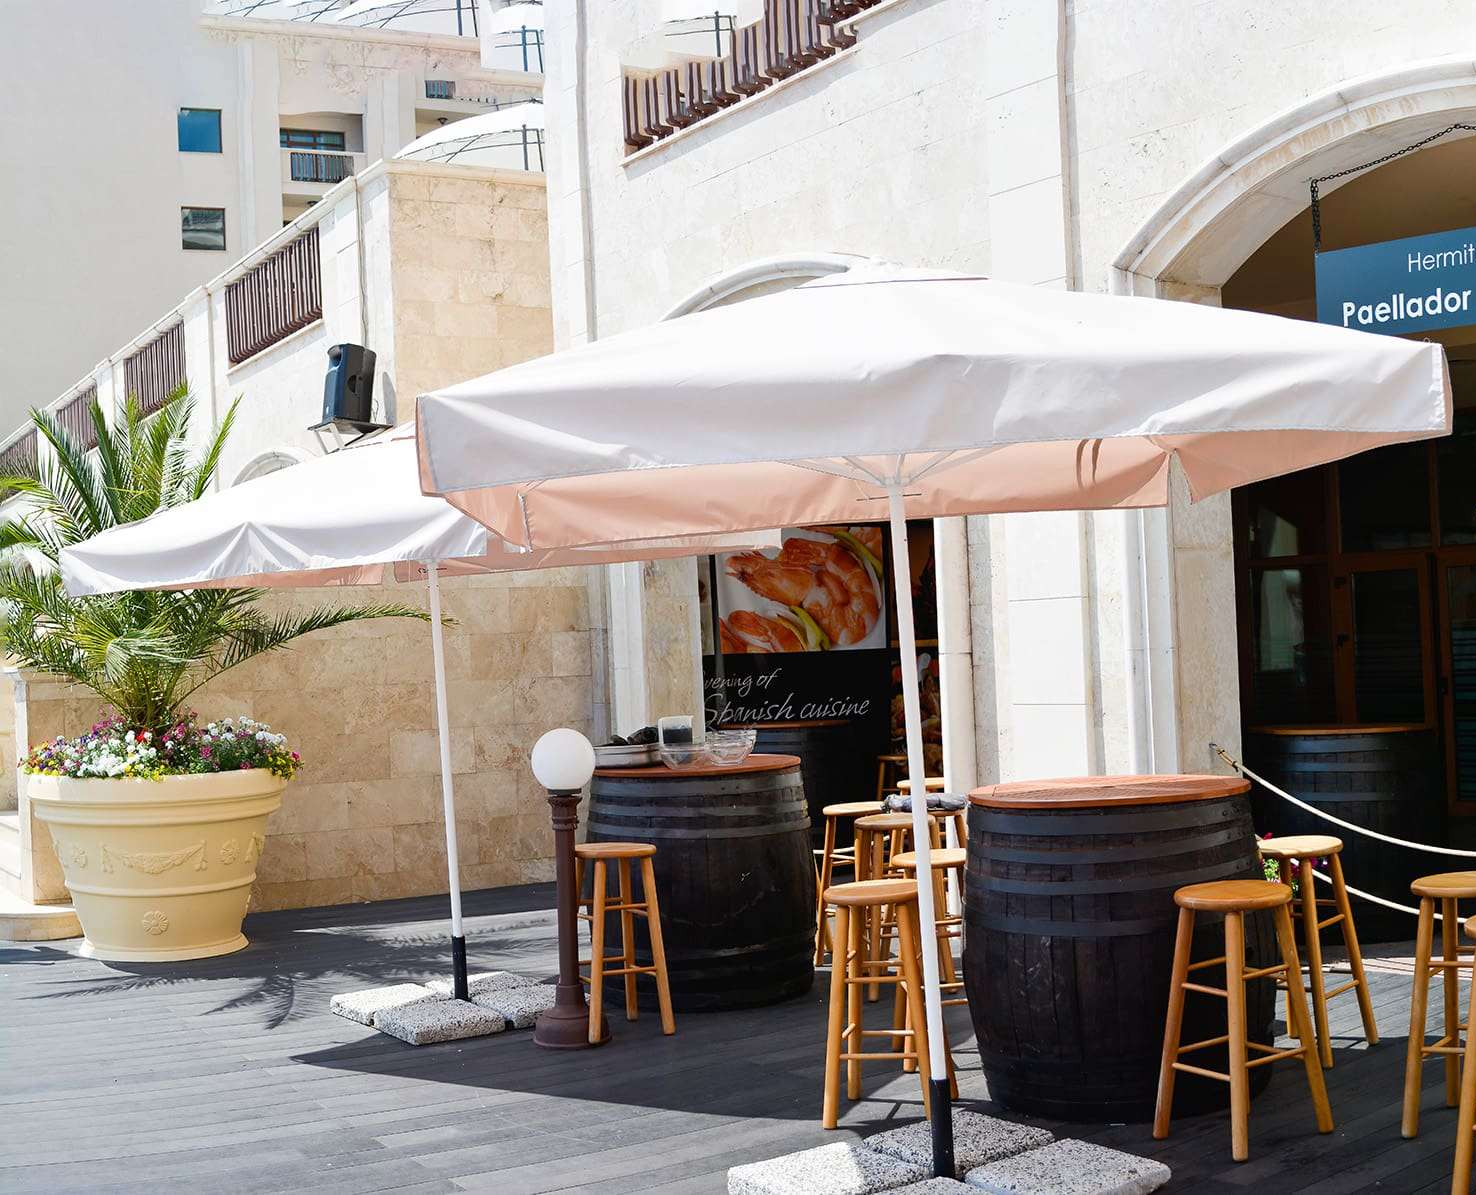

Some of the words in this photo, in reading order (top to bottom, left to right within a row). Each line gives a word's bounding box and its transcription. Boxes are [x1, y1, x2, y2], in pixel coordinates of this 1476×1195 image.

[1342, 287, 1472, 328] Paellador
[704, 671, 753, 698] vening
[756, 667, 783, 690] of
[704, 692, 796, 729] Spanish
[799, 696, 871, 720] cuisine
